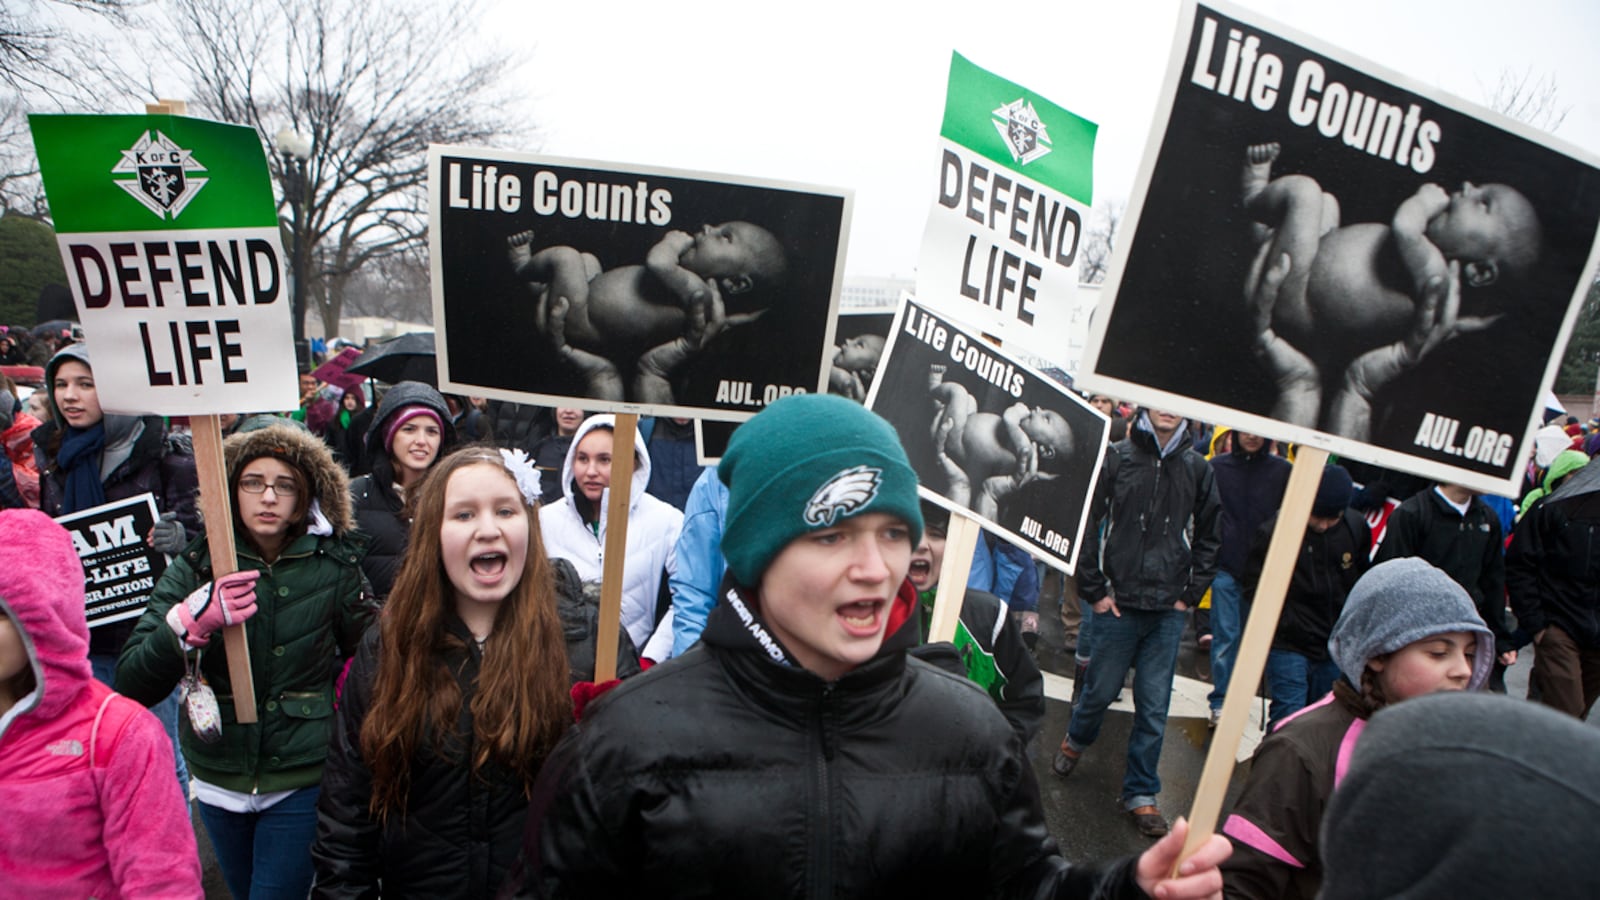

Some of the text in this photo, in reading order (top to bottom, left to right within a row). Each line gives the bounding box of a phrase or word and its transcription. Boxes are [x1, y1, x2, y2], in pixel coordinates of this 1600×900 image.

[1031, 119, 1039, 130] C
[1191, 17, 1441, 174] Life Counts
[136, 151, 181, 164] K OF C
[449, 163, 673, 226] Life Counts
[938, 148, 1082, 268] DEFEND
[69, 238, 280, 308] DEFEND
[960, 234, 1043, 327] LIFE
[139, 319, 248, 386] LIFE
[904, 305, 1025, 398] Life Counts
[1414, 412, 1513, 467] AUL.ORG
[1020, 515, 1070, 556] AUL.ORG
[84, 556, 151, 584] -LIFE
[85, 576, 155, 604] ERATION
[748, 623, 788, 665] ARMO
